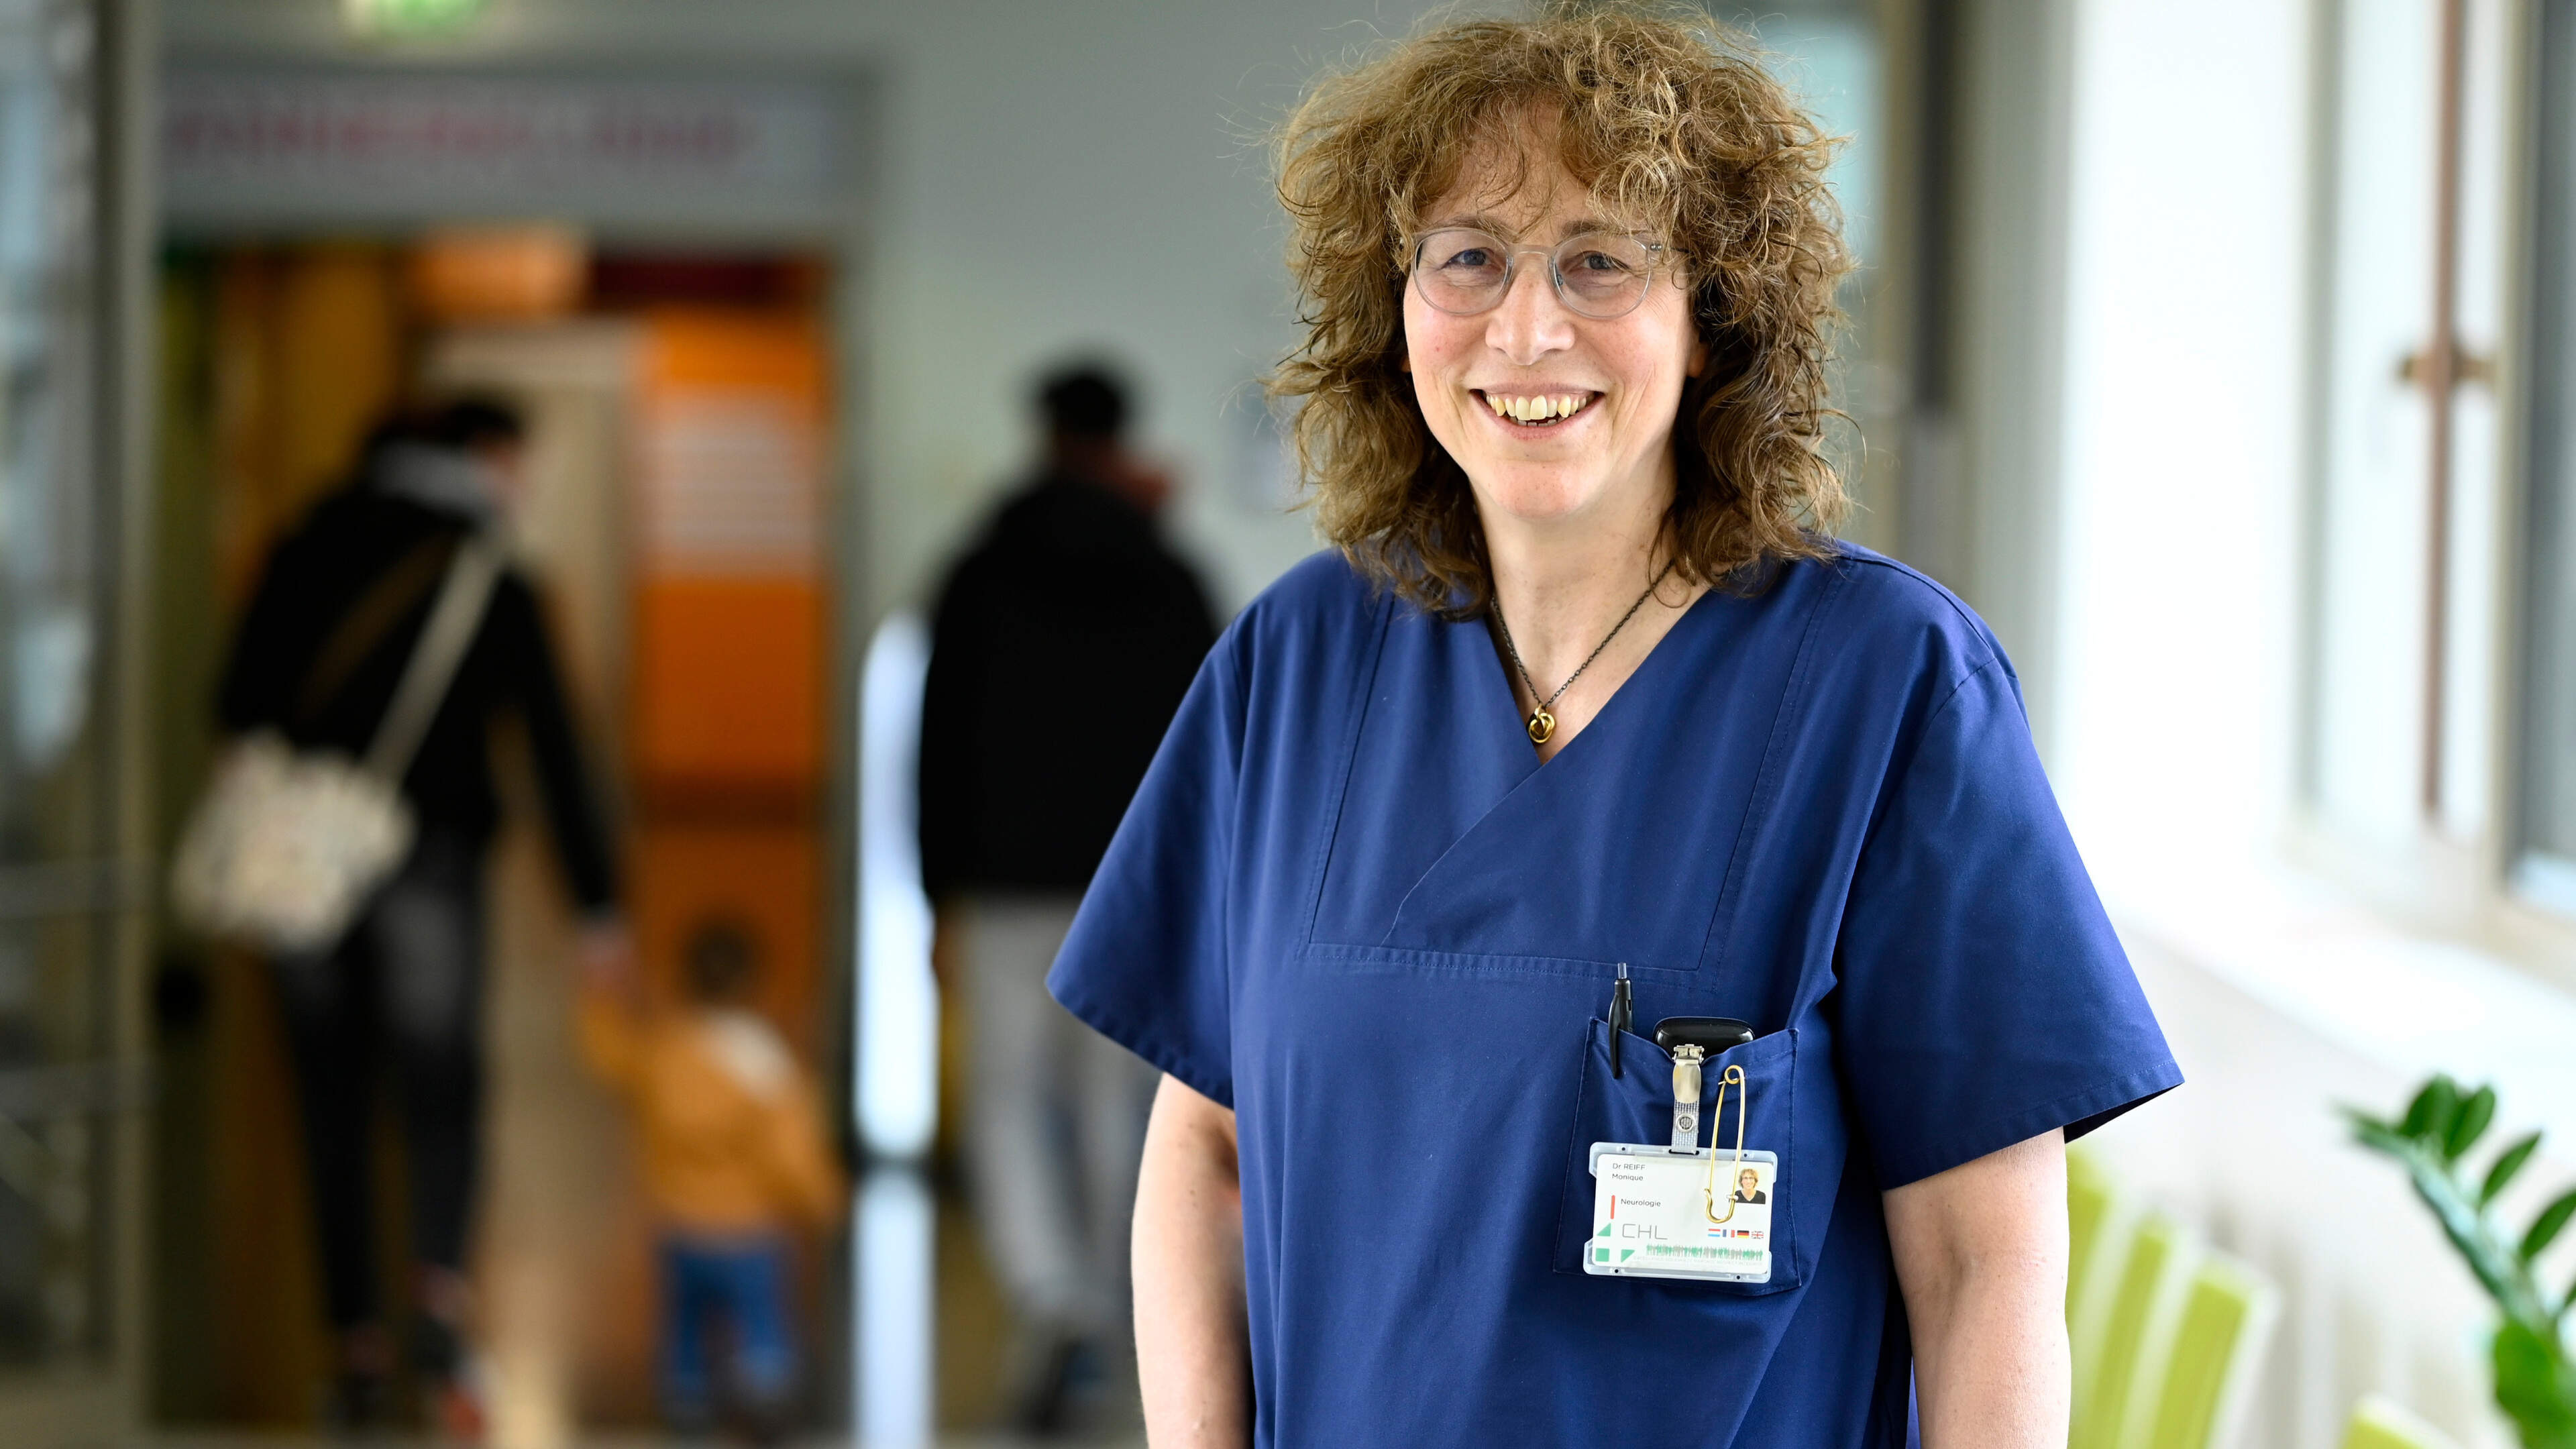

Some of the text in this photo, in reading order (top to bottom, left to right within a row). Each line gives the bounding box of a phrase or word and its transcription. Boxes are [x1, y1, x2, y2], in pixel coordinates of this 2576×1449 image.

[1612, 1173, 1644, 1181] Monique
[1621, 1198, 1661, 1208] Neurologie
[1622, 1223, 1668, 1240] CHL
